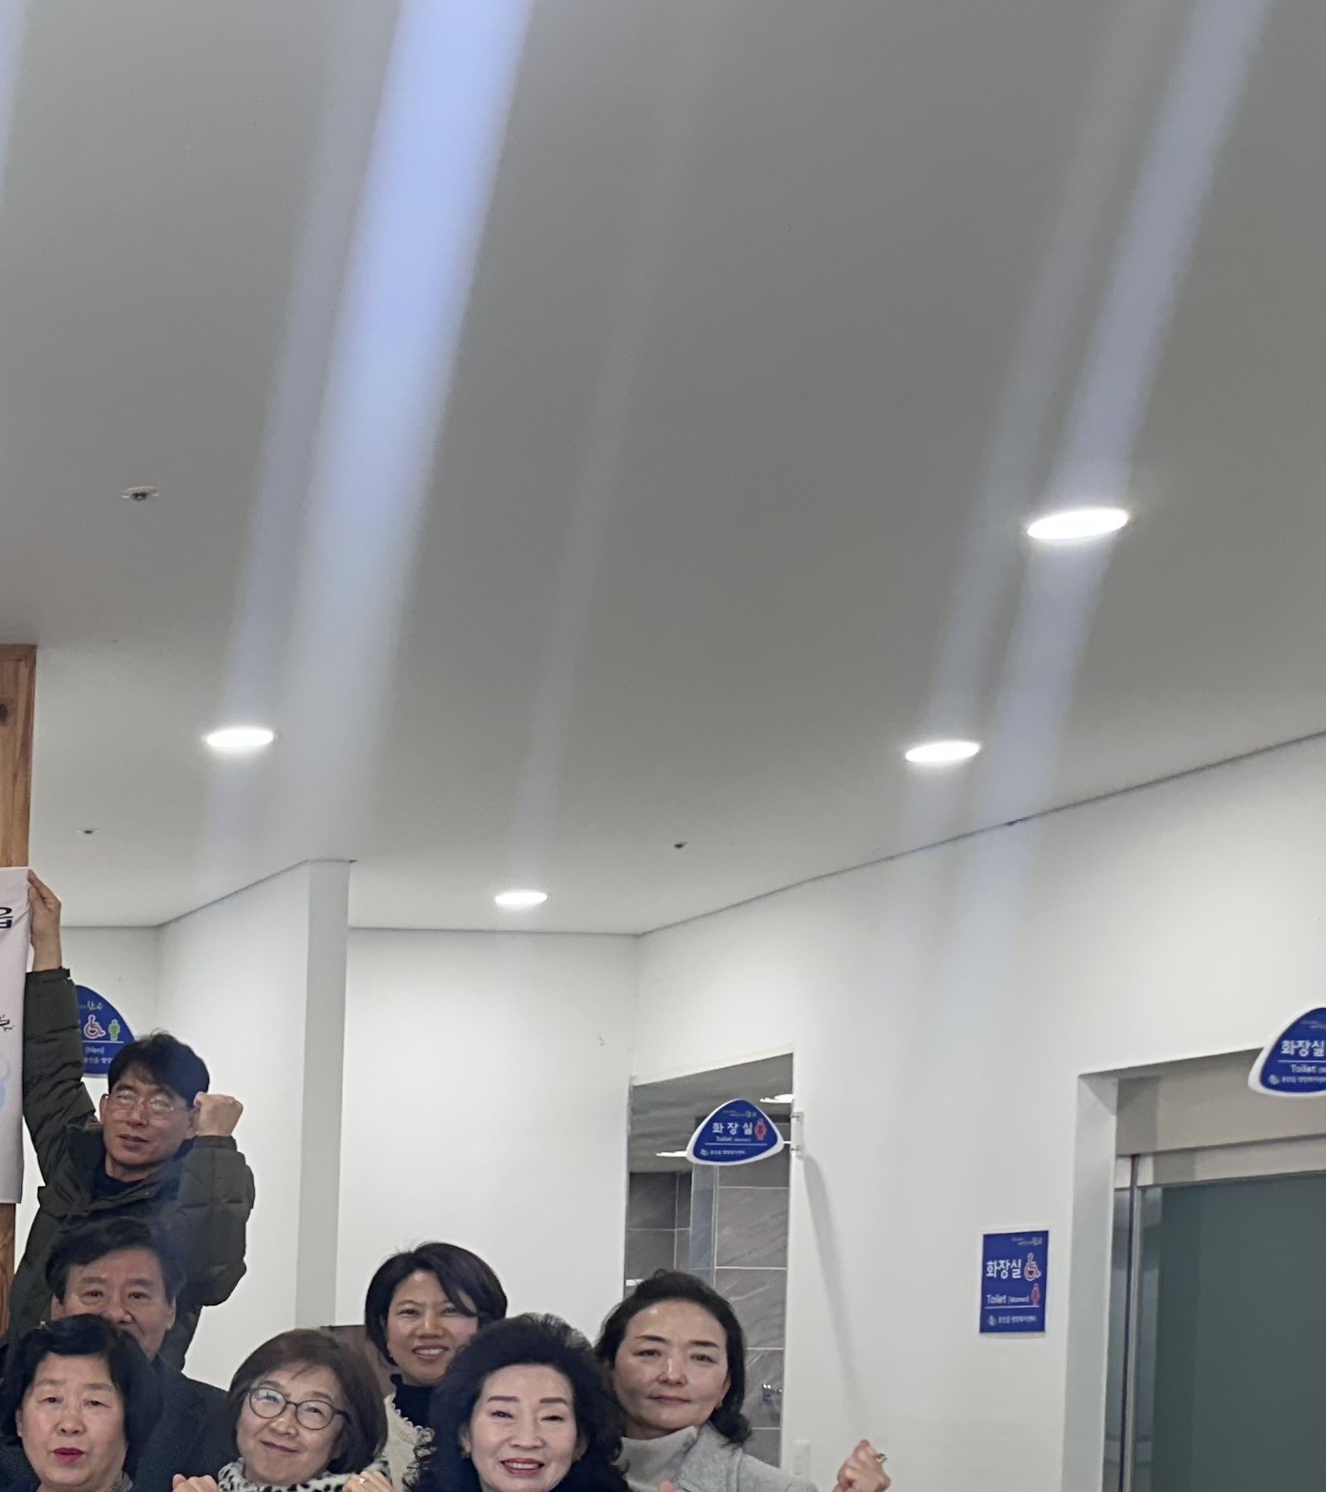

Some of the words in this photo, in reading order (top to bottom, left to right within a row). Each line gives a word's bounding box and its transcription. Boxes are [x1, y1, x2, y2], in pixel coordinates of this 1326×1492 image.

[1281, 1041, 1324, 1056] 화장실
[1291, 1064, 1316, 1073] Toilet
[712, 1122, 752, 1135] 화장실
[986, 1259, 1021, 1279] 화장실
[987, 1295, 1006, 1304] Toilet
